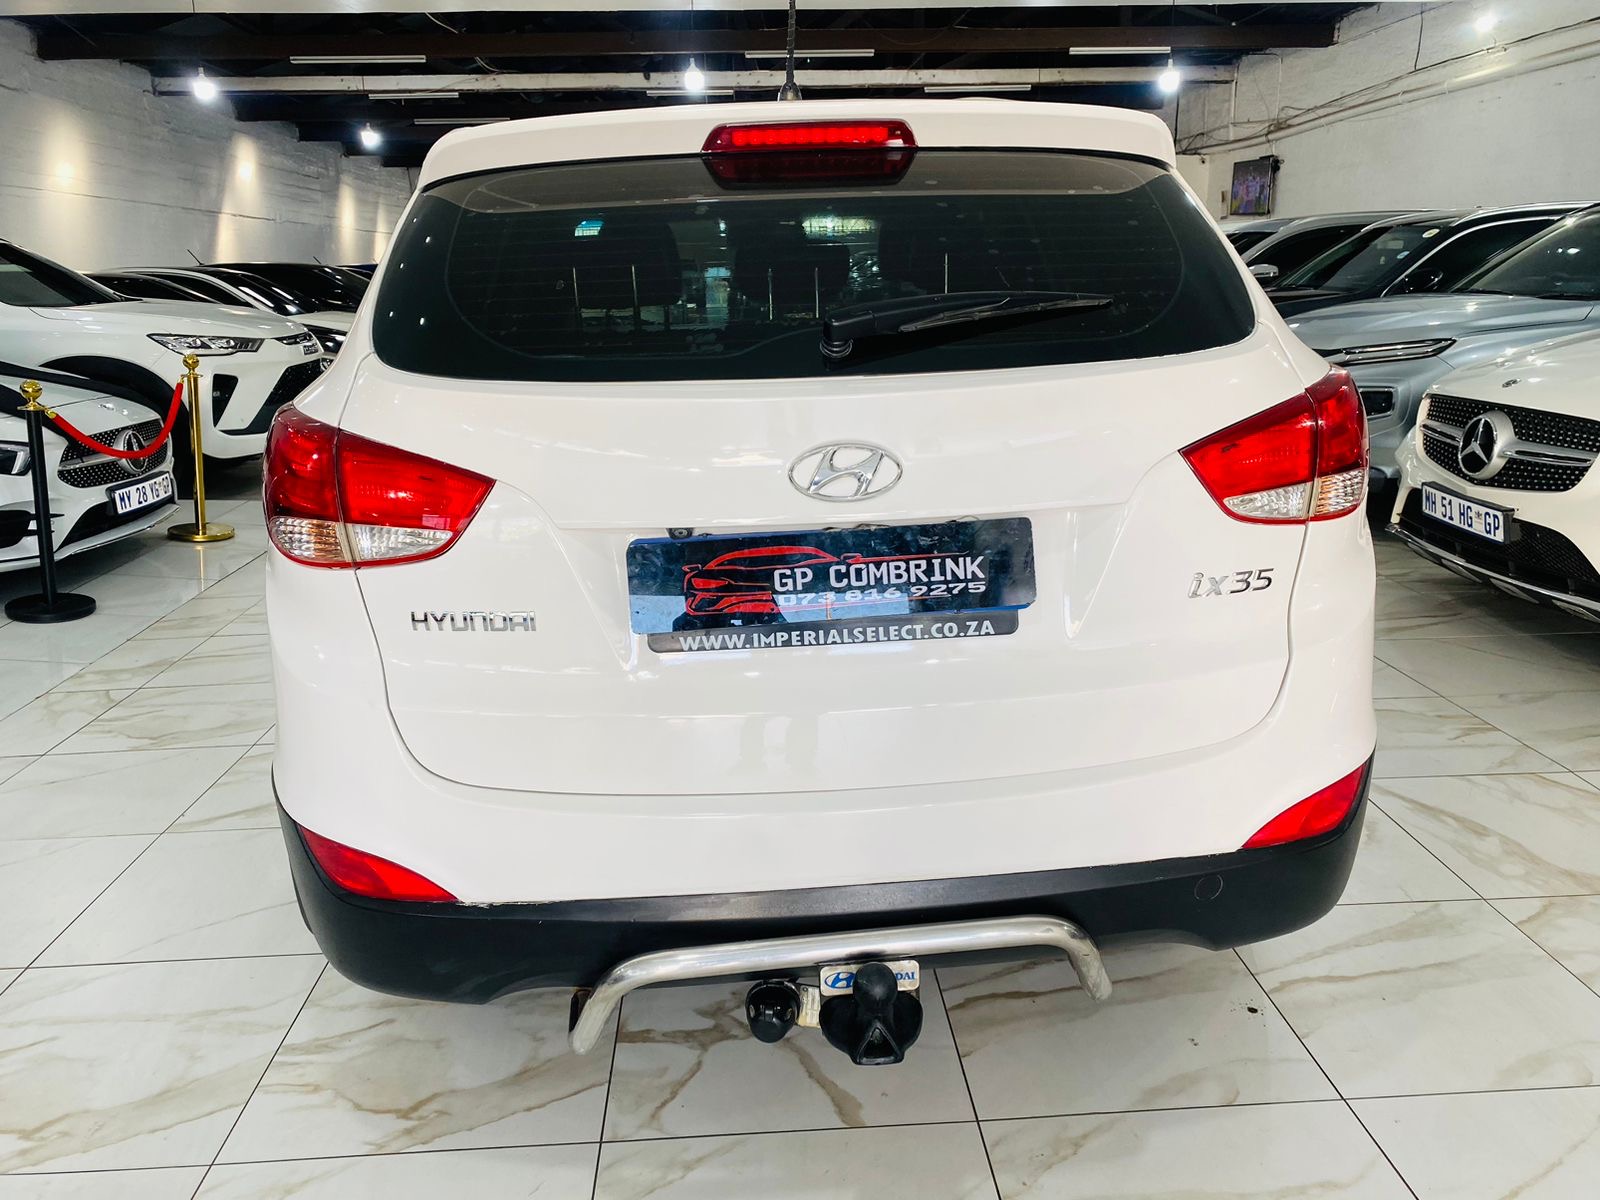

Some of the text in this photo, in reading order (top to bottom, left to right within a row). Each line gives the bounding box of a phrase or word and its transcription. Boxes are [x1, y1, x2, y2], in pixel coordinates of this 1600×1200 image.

[118, 489, 132, 510] MY
[136, 485, 148, 505] 28
[149, 480, 160, 500] YG
[1424, 487, 1500, 537] MH 51 HG GP
[773, 555, 986, 592] GP COMBRINK
[1188, 568, 1275, 599] ix35
[778, 581, 987, 606] 073 816 9275
[410, 610, 537, 632] HYUNDAI
[679, 620, 996, 652] WWW.IMPERIALSELECT.CO.ZA
